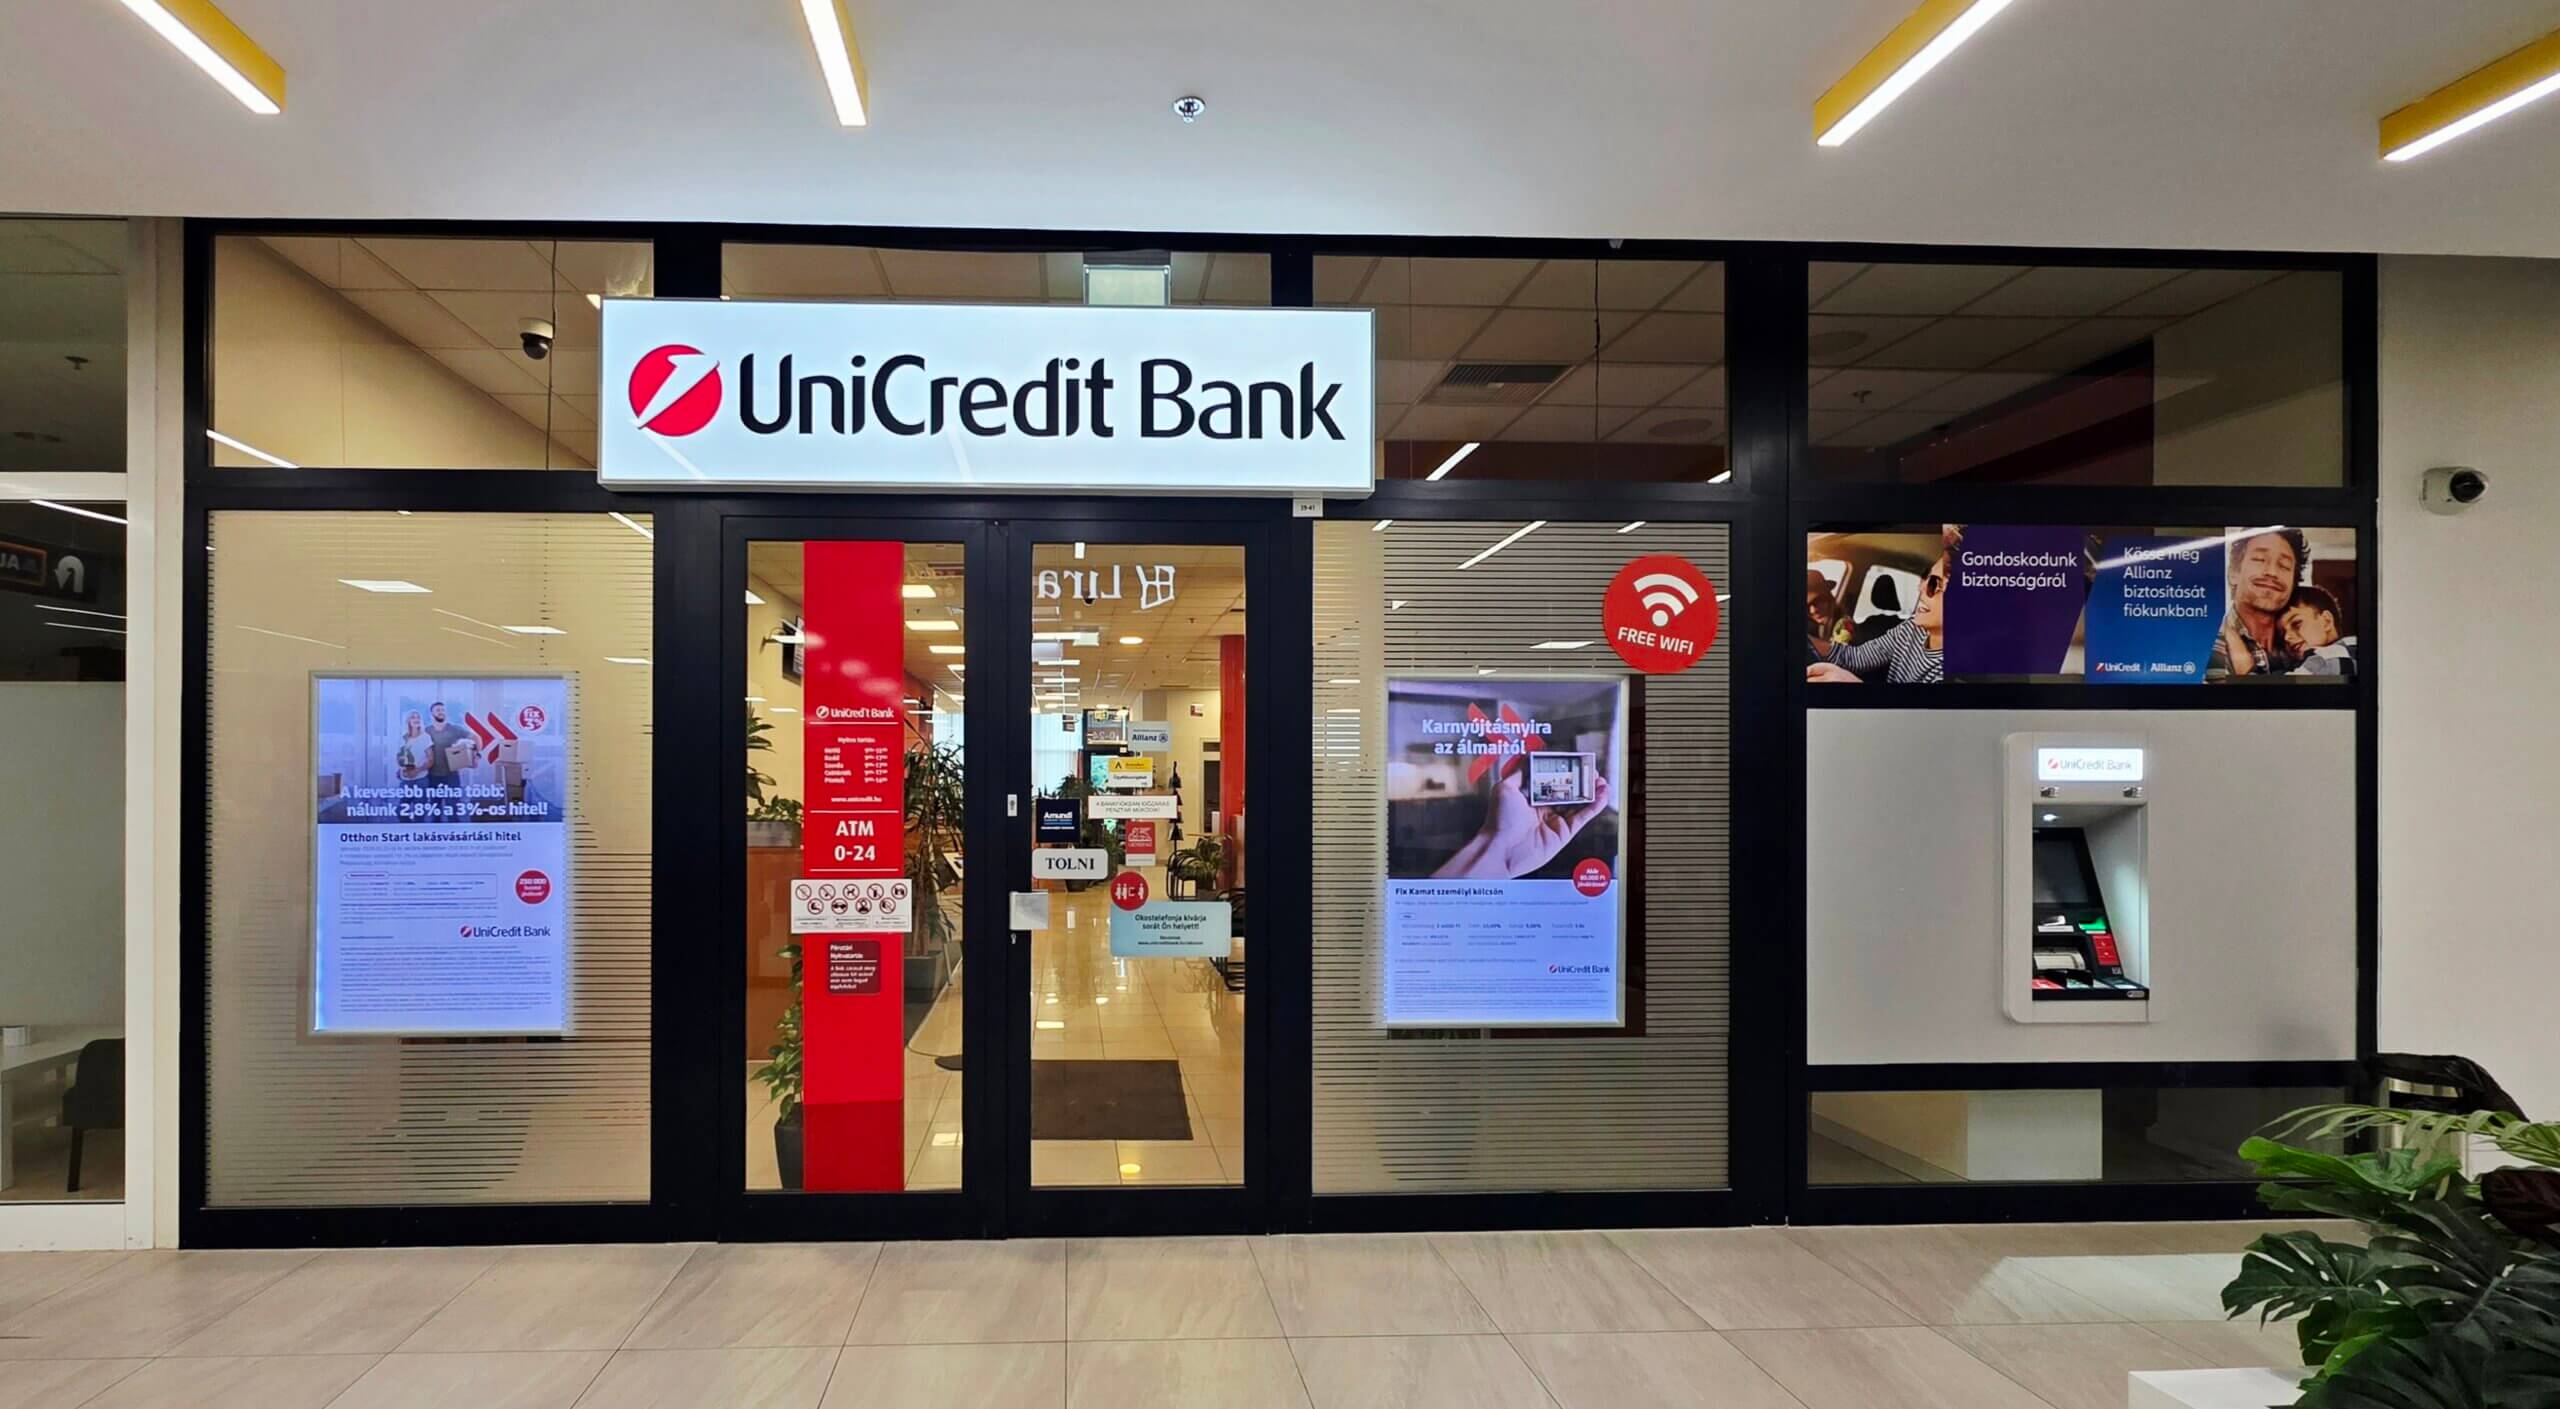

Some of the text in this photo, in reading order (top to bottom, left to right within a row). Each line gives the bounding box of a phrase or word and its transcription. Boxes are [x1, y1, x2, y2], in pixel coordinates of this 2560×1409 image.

[739, 353, 1346, 441] UniCredit Bank
[1961, 551, 2077, 568] Gondoskodunk
[2122, 546, 2200, 564] Kösse meg
[2123, 565, 2173, 580] Allianz
[1962, 571, 2068, 591] biztonságáról
[2123, 584, 2206, 599] biztosítását
[2123, 602, 2208, 618] fiókunkban!
[1617, 626, 1695, 656] FREE WIFI
[2104, 662, 2141, 673] UniCredit
[2150, 662, 2183, 673] Allianz
[830, 707, 895, 719] UniCredit Bank
[1422, 718, 1552, 738] Karnyújtásnyira
[1131, 734, 1158, 742] Allianz
[1434, 739, 1527, 755] az álmaitól
[2060, 758, 2133, 771] UniCredit Bank
[340, 783, 505, 799] A kevesebb néha több:
[347, 801, 548, 819] nálunk 2,8% a 3%-os hitel!
[1043, 811, 1073, 819] Amundi
[836, 820, 875, 837] ATM
[340, 831, 522, 843] Otthon Start lakásvásárlási hitel
[834, 845, 876, 862] 0-24
[1045, 857, 1095, 870] TOLNI
[1395, 887, 1504, 898] Fix Kamat személyi kölcsön
[1135, 913, 1182, 923] Okostelefonja
[473, 926, 551, 938] UniCredit Bank
[1558, 965, 1610, 974] UniCredit Bank
